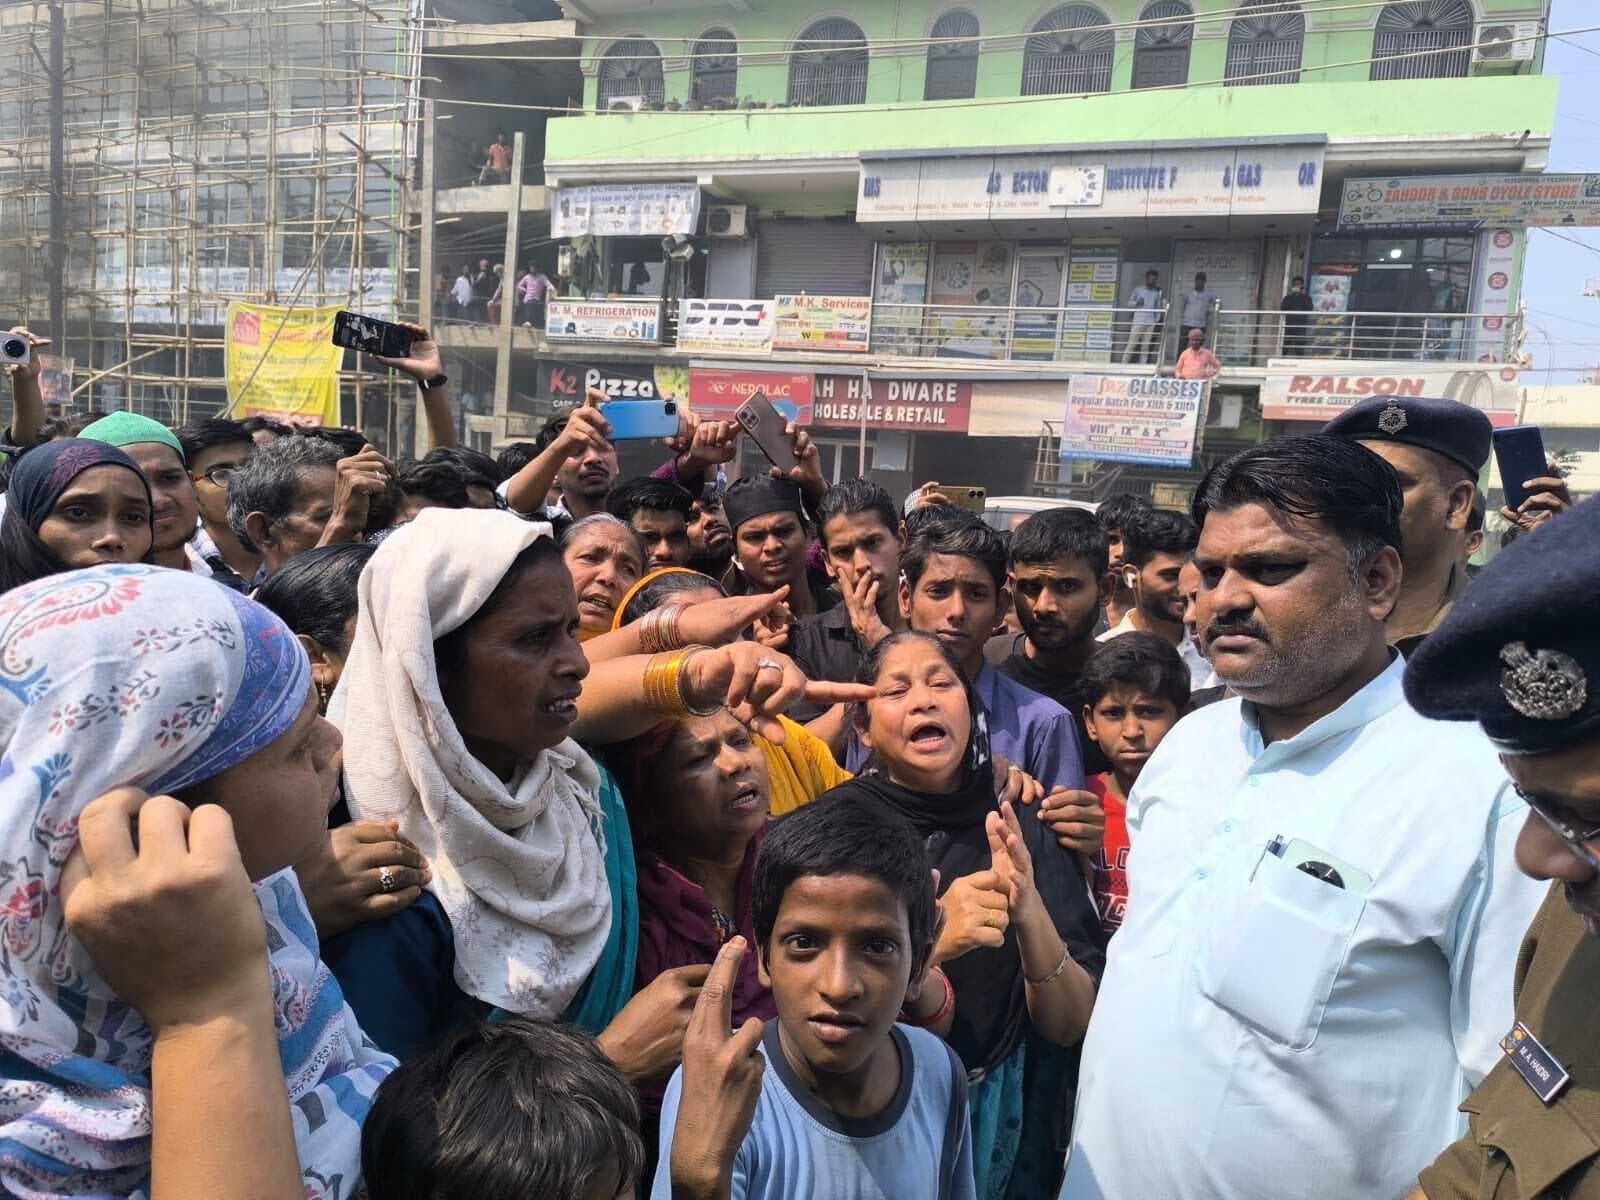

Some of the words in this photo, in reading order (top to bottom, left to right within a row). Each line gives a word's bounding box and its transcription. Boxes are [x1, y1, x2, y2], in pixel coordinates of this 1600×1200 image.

[1012, 170, 1049, 194] ECTOR
[1106, 166, 1166, 191] INSTITUTE
[1169, 166, 1178, 189] F
[1222, 165, 1231, 188] &
[1237, 163, 1262, 188] GAS
[1298, 162, 1317, 187] OR
[1534, 184, 1579, 200] STORE
[821, 298, 870, 310] Services
[576, 305, 657, 318] REFRIGERATION
[731, 383, 791, 397] NEROLAC
[1129, 378, 1200, 398] CLASSES
[1288, 374, 1426, 396] RALSON
[1071, 395, 1105, 407] Regular
[1105, 397, 1129, 407] Batch
[1131, 398, 1144, 408] For
[1286, 396, 1324, 404] TYRES
[885, 406, 894, 421] &
[896, 406, 946, 424] RETAIL
[1142, 428, 1150, 437] &
